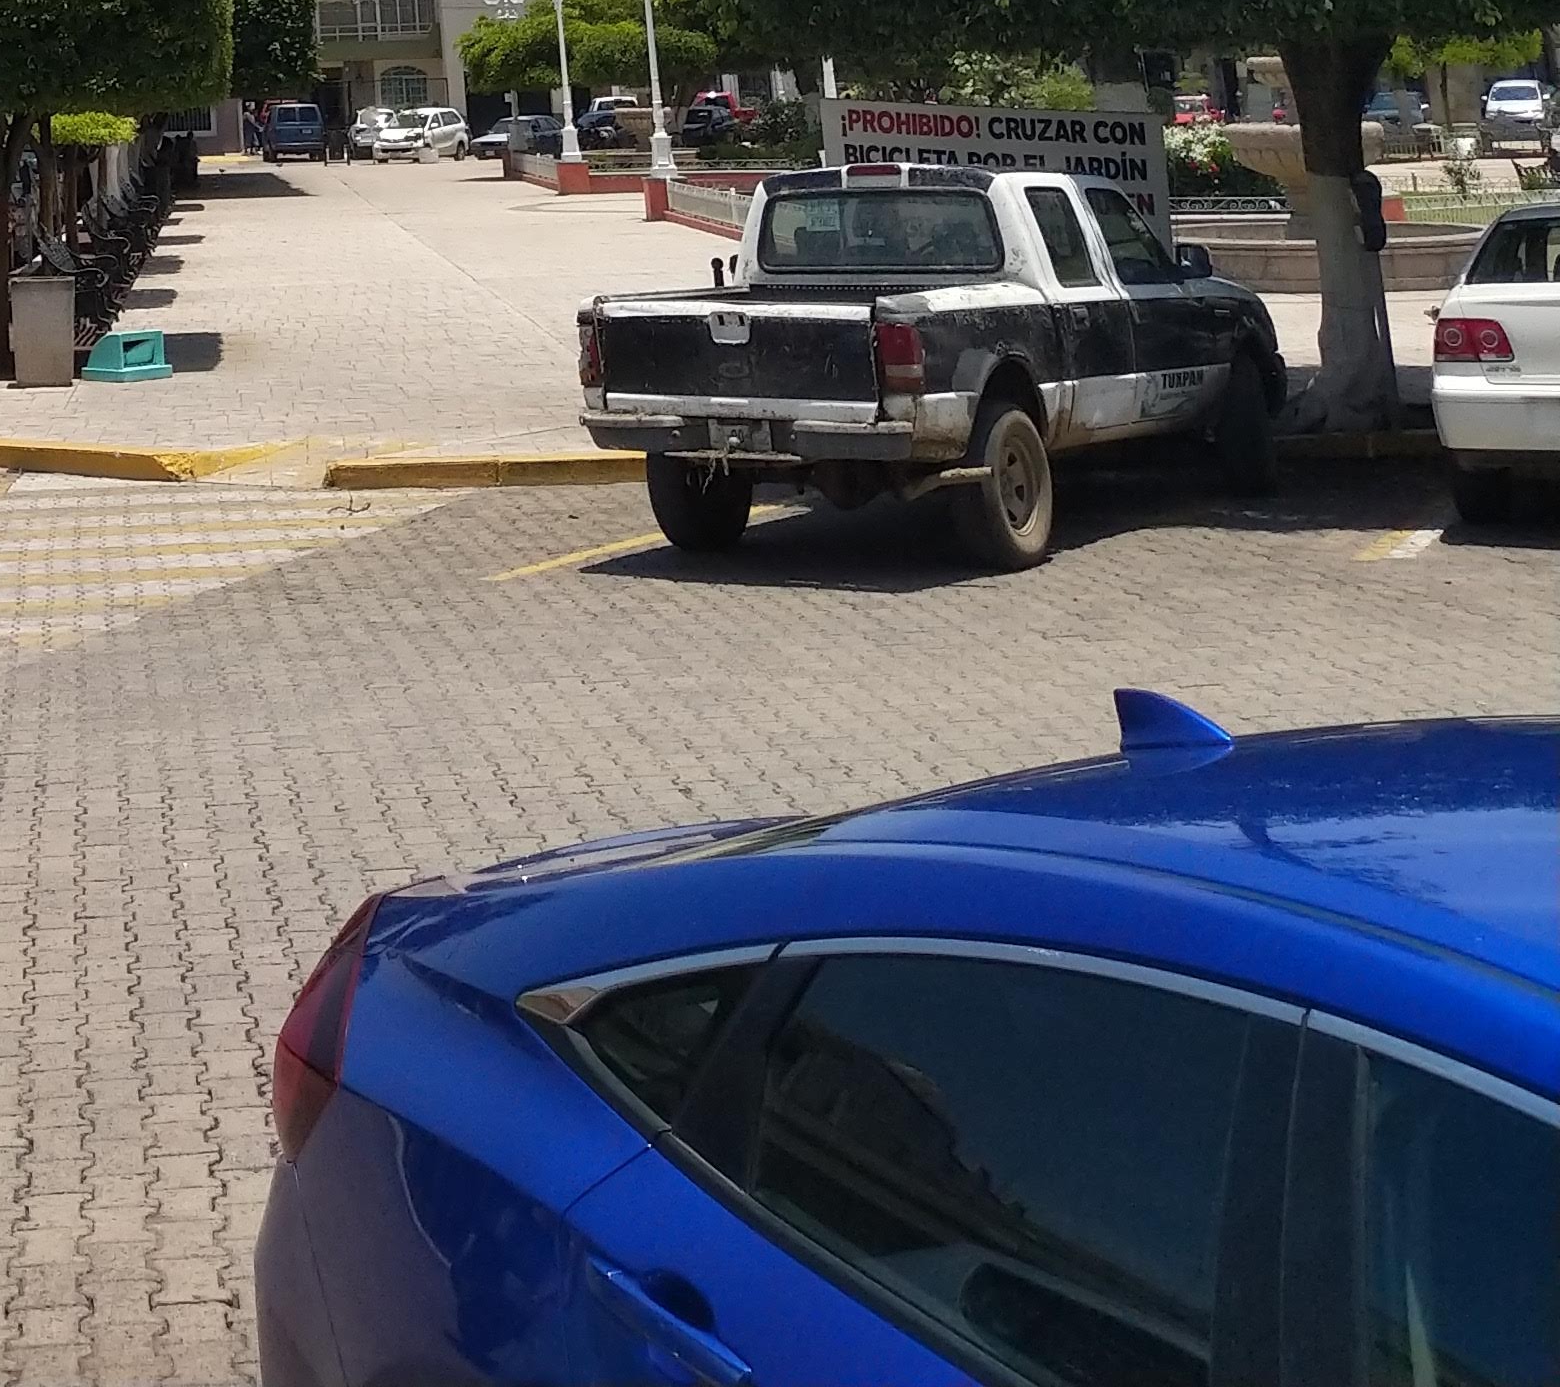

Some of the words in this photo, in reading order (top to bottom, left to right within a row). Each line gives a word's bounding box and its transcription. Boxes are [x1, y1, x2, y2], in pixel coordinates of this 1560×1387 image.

[841, 108, 981, 139] ¡PROHIBIDO!
[987, 116, 1088, 144] CRUZAR
[1093, 120, 1146, 146] CON
[1064, 151, 1148, 181] JARDÍN
[1161, 369, 1204, 389] TUXPAN
